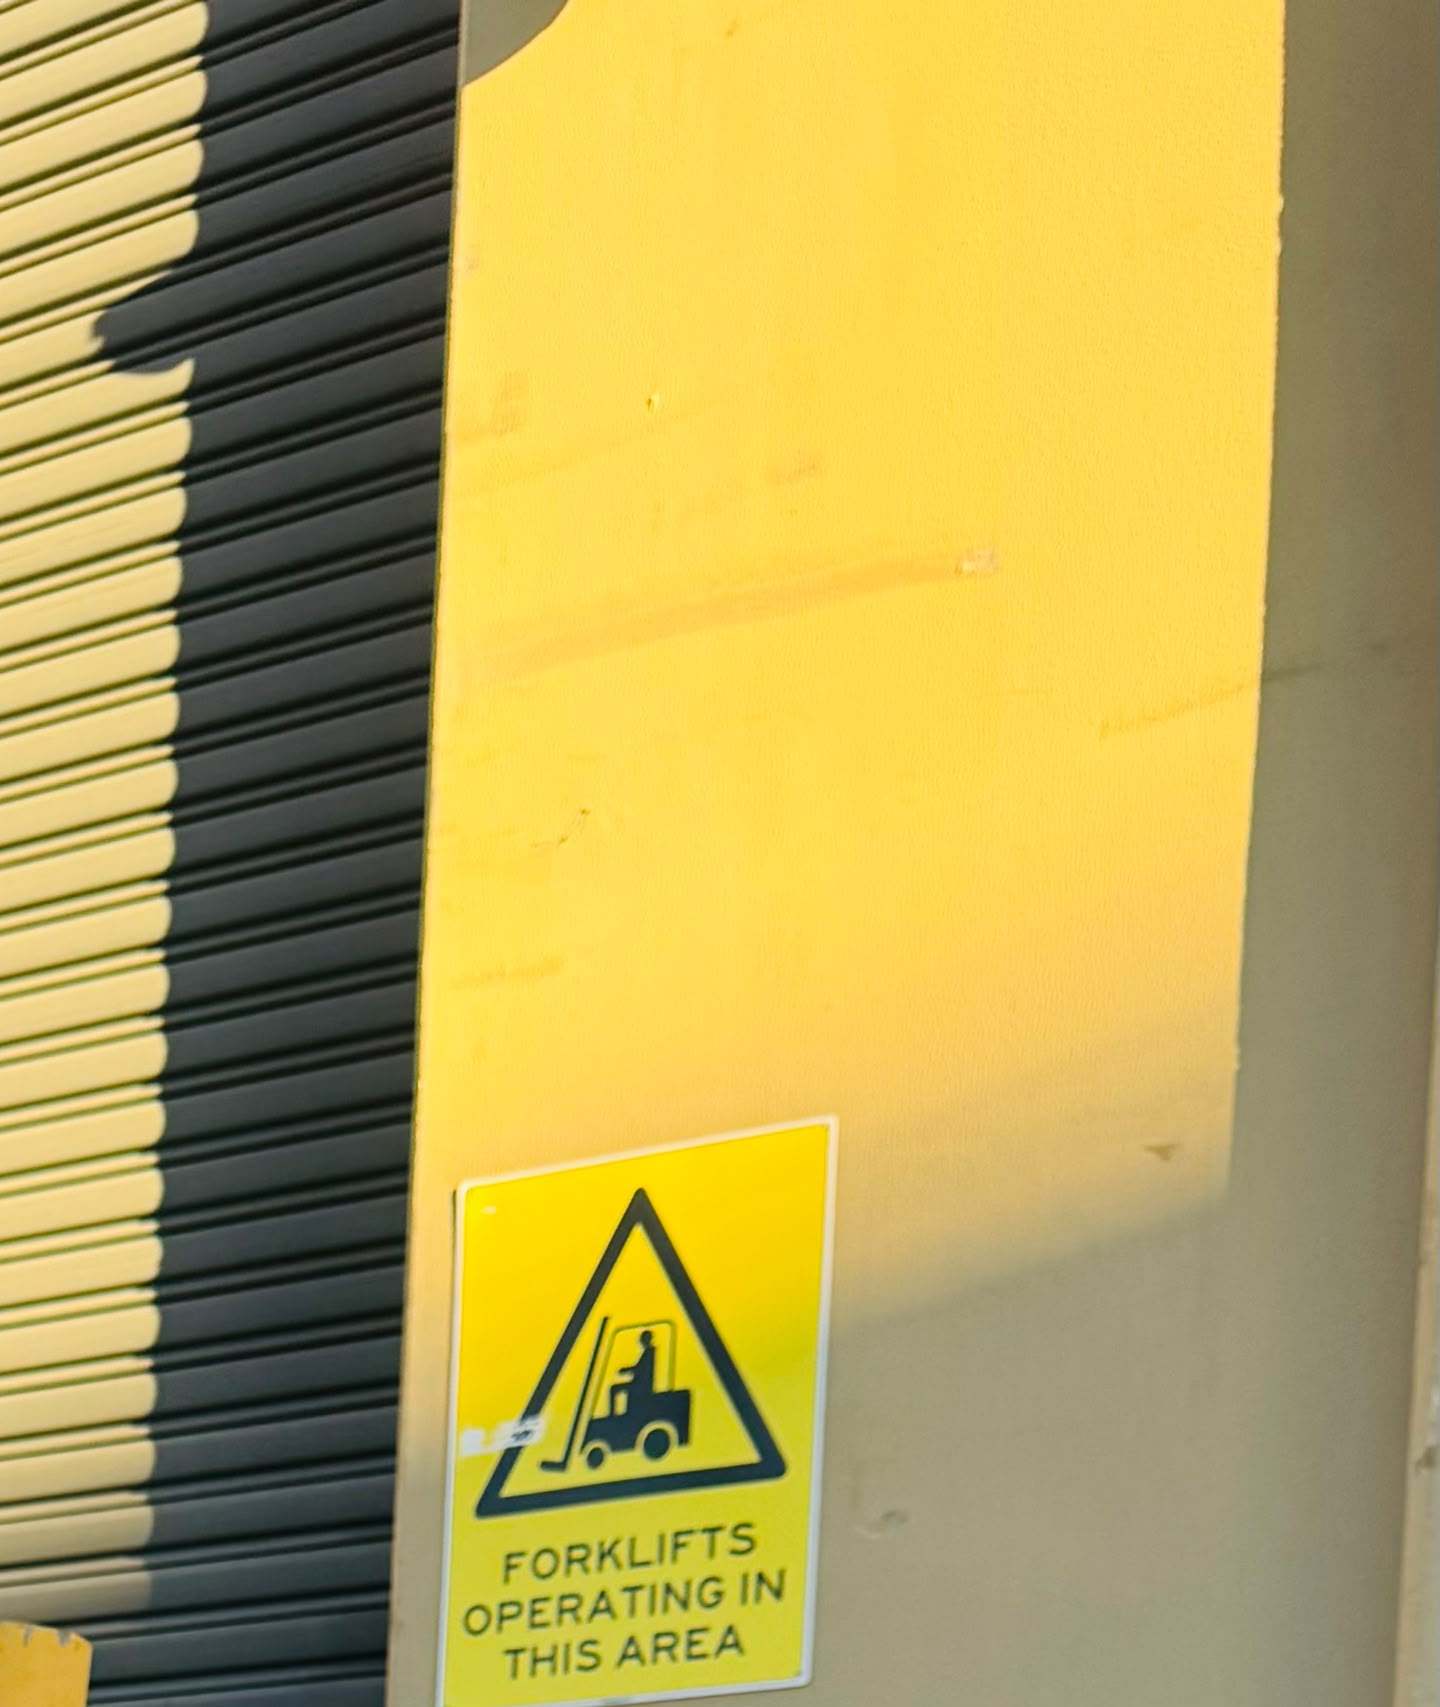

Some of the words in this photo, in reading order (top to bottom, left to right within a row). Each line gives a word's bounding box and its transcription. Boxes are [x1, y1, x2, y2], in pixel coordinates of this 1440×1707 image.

[503, 1523, 757, 1585] FORKLIFTS
[463, 1575, 725, 1636] OPERATING
[740, 1569, 786, 1605] IN
[504, 1639, 601, 1680] THIS
[617, 1625, 744, 1668] AREA
